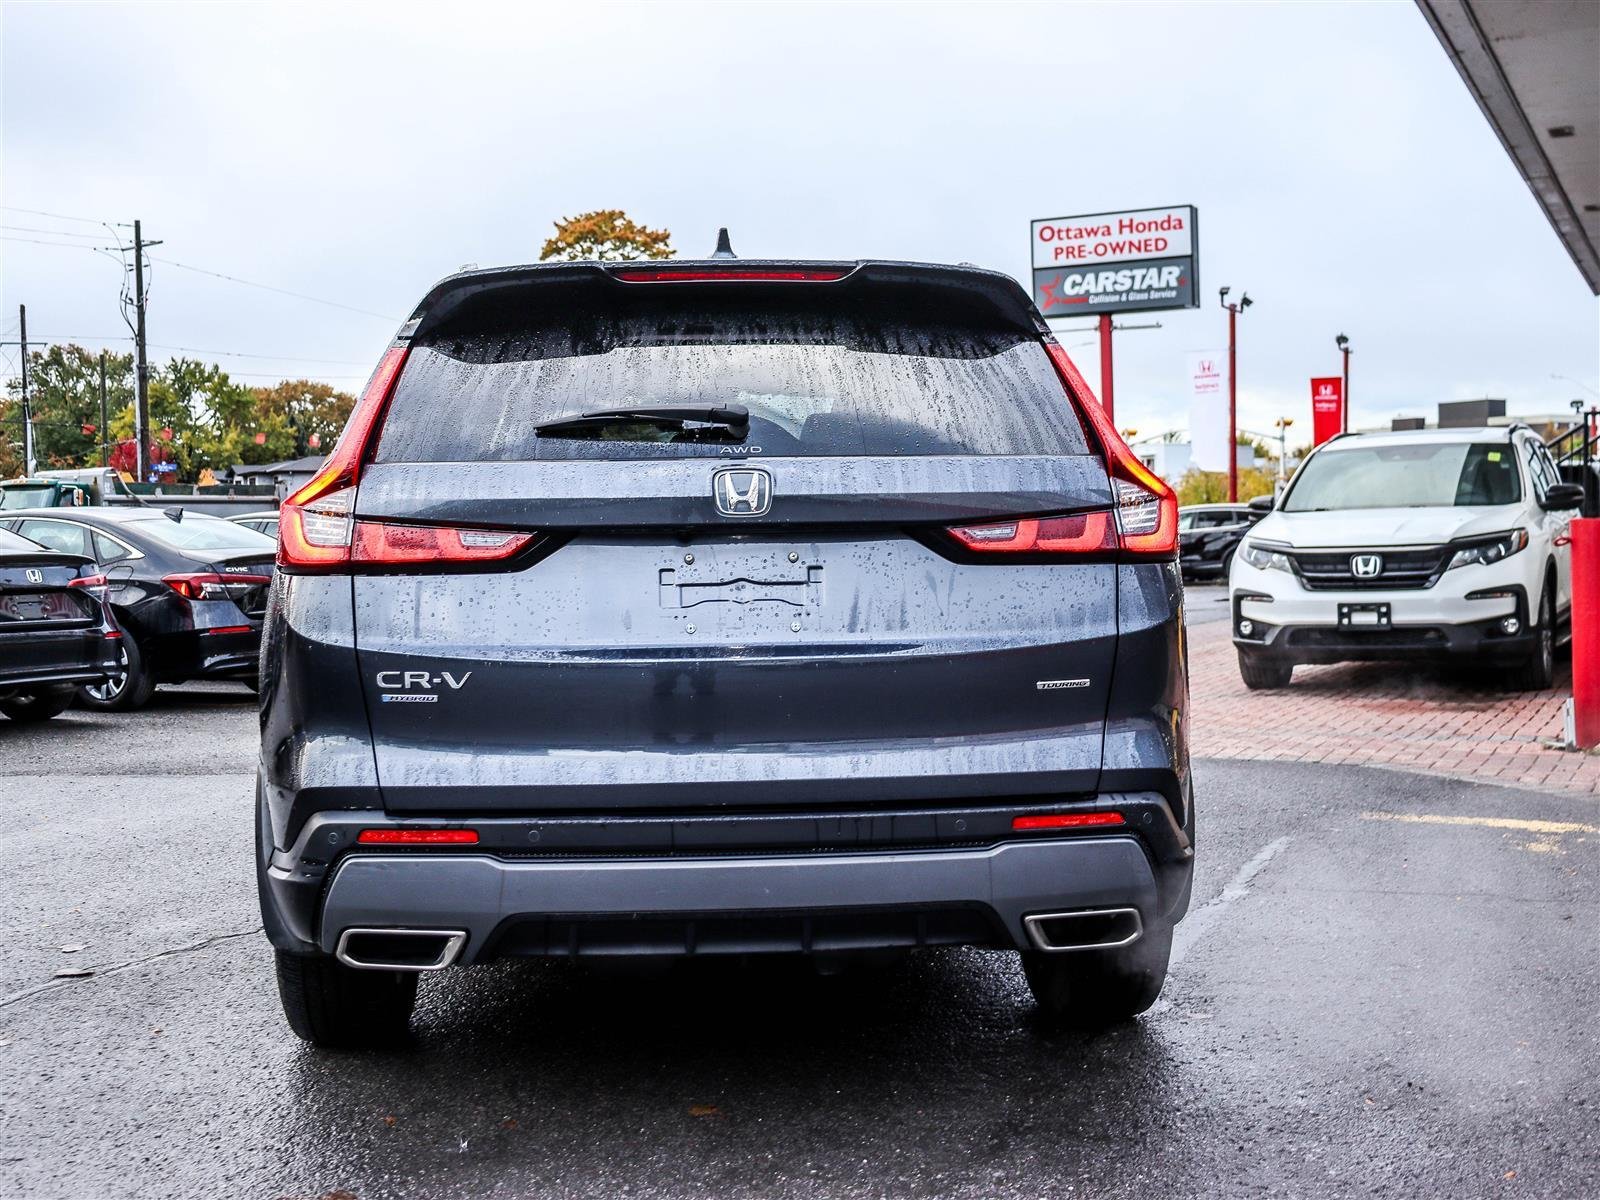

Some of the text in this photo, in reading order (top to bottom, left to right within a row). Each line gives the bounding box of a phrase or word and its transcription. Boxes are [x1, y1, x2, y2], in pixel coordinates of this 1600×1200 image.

[1039, 214, 1184, 242] Ottawa Honda
[1054, 237, 1168, 260] PRE-OWNED
[1063, 266, 1181, 296] CARSTAR
[720, 446, 762, 454] AWD
[376, 671, 472, 689] CR-V
[1039, 680, 1089, 689] TOURING
[389, 694, 437, 702] HYBRID
